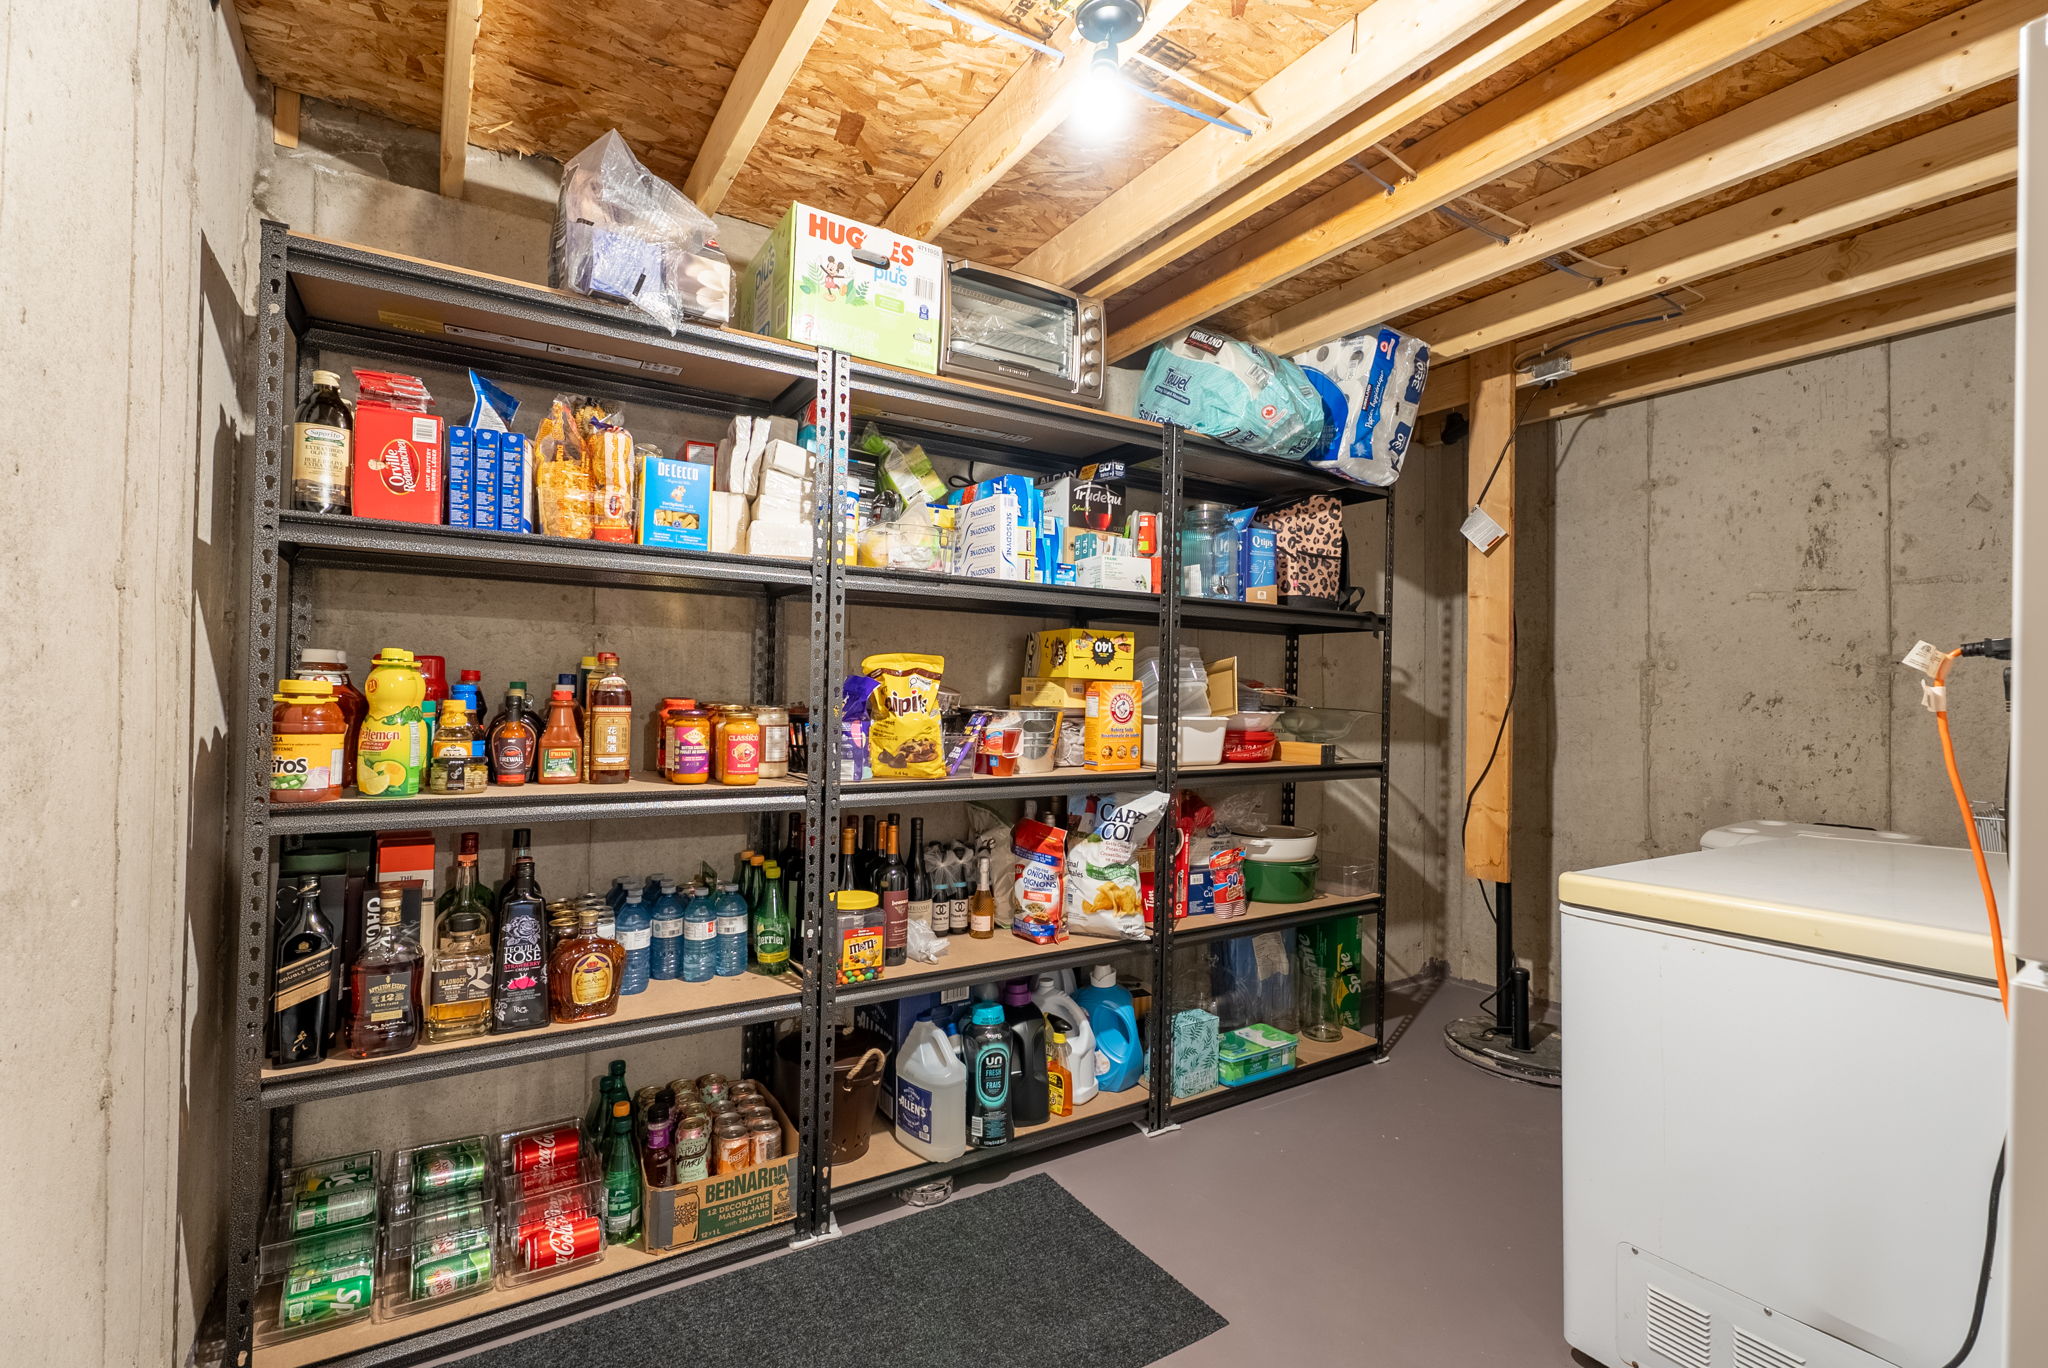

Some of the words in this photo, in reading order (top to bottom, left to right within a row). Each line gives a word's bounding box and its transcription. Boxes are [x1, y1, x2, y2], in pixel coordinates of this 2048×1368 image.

[808, 213, 914, 266] HUGES
[1190, 329, 1223, 349] KIRKLAND
[1164, 368, 1192, 391] Towel
[1392, 433, 1404, 449] 30
[386, 449, 405, 486] Orville
[1075, 486, 1122, 506] Trudeau
[970, 505, 996, 518] SENSODYNE
[970, 524, 996, 536] SENSODYNE
[970, 546, 996, 557] SENSODYNE
[970, 567, 996, 577] SENSODYNE
[1095, 642, 1113, 652] 140
[1027, 868, 1055, 881] ONIONS
[1227, 872, 1238, 889] 30
[1023, 877, 1057, 889] OIGNONS
[504, 944, 541, 953] TEQUILA
[504, 950, 542, 965] ROSE
[307, 960, 330, 971] BLACK
[504, 961, 541, 970] STRAWBERRY
[380, 993, 395, 1002] 12
[985, 1068, 1002, 1076] FRESH
[985, 1081, 1001, 1089] FRAIS
[898, 1095, 927, 1118] ALLEN'S
[680, 1156, 704, 1169] HARD
[707, 1208, 717, 1216] 12
[719, 1193, 770, 1213] DECORATIVE
[719, 1207, 748, 1221] MASON
[750, 1201, 770, 1212] JARS
[739, 1213, 758, 1223] SNAP
